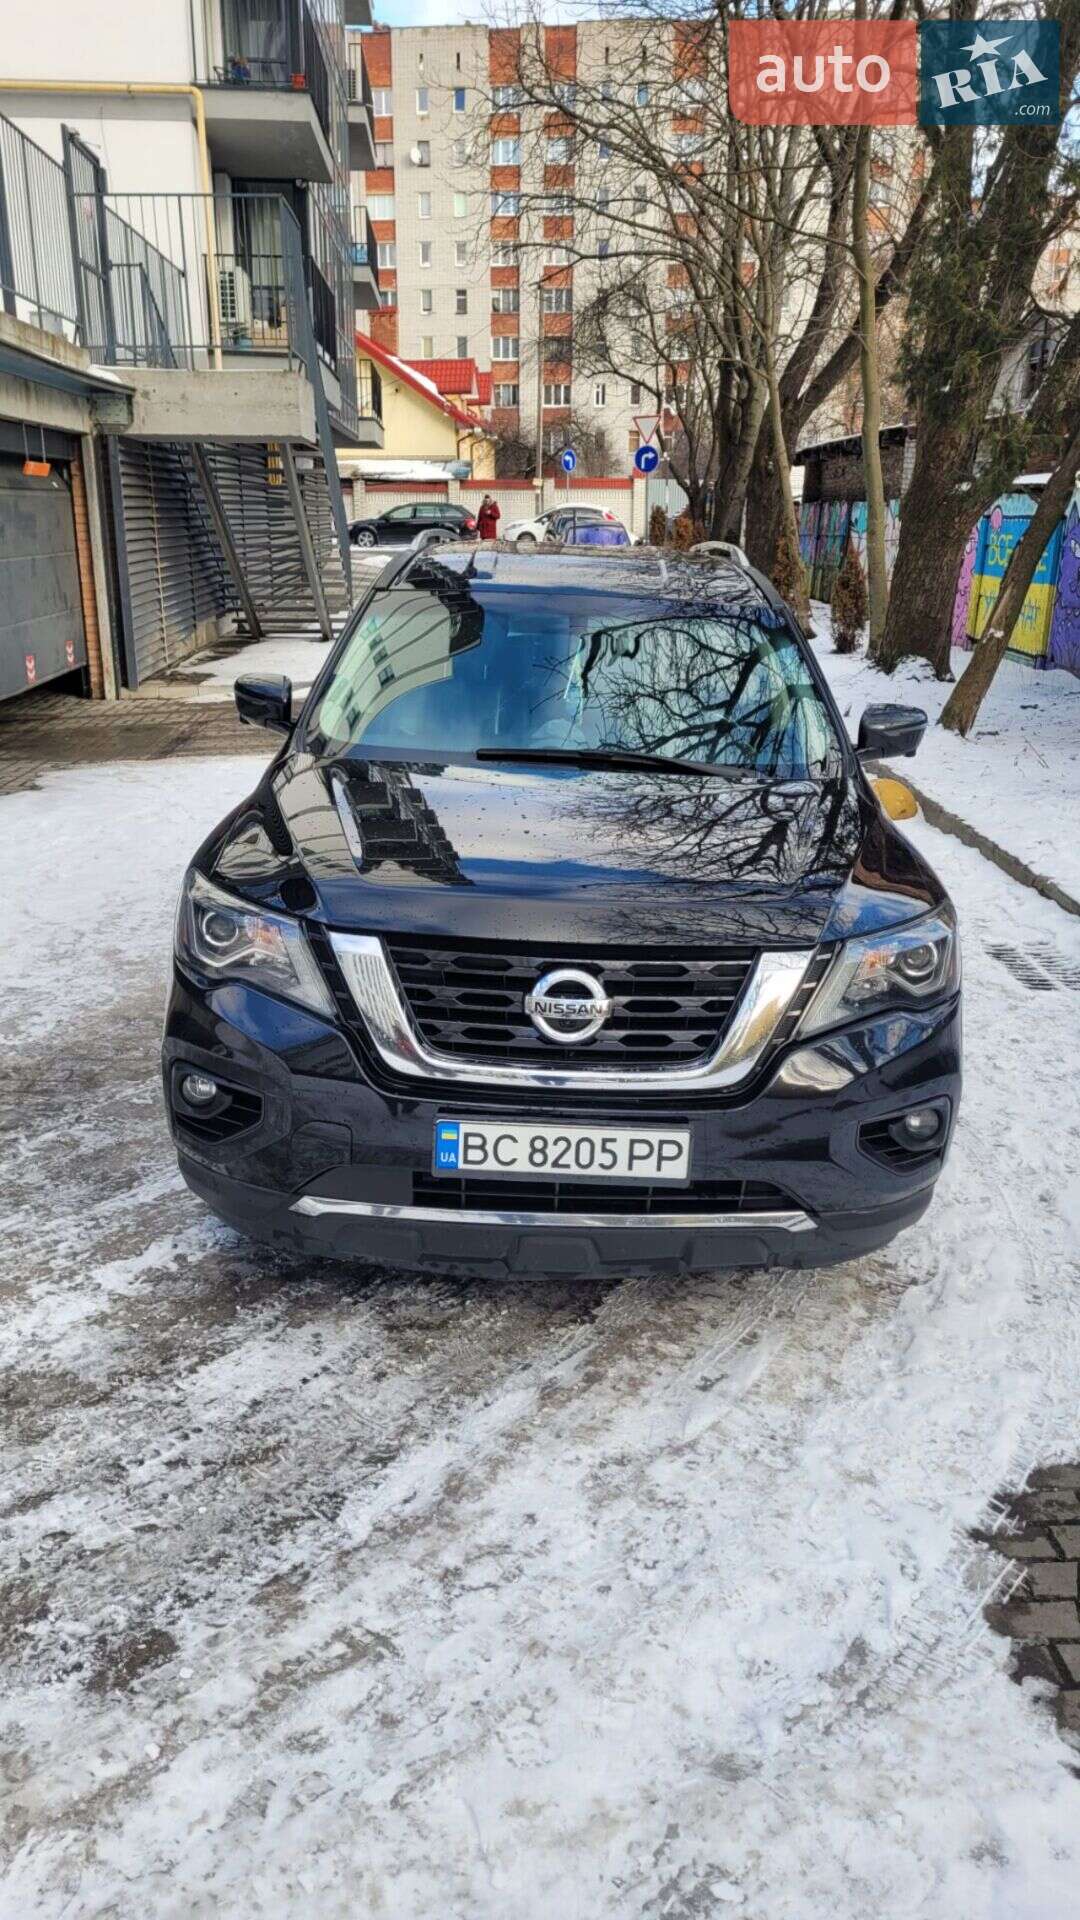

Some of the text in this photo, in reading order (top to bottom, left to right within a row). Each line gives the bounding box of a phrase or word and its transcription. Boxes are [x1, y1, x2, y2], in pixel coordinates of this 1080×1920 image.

[534, 1001, 603, 1016] NISSAN
[440, 1151, 457, 1163] UA
[462, 1132, 684, 1172] BC 8205 PP
